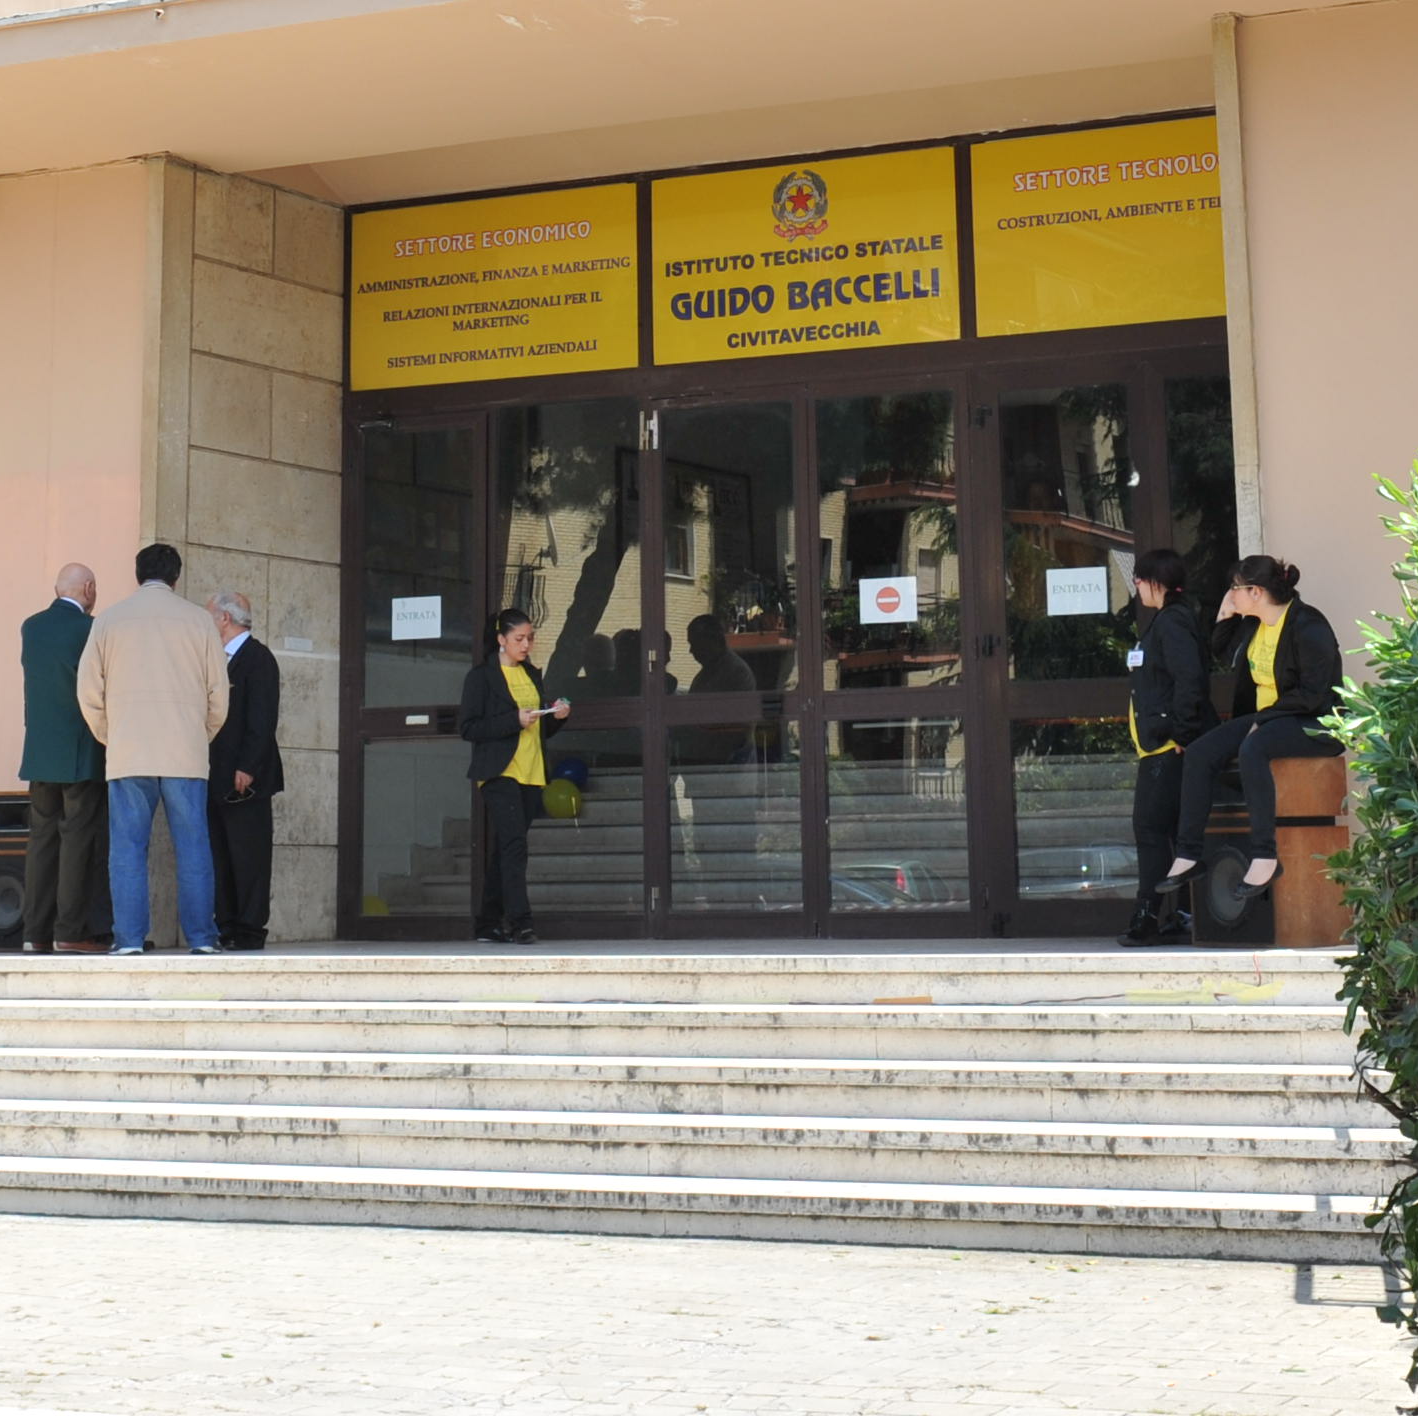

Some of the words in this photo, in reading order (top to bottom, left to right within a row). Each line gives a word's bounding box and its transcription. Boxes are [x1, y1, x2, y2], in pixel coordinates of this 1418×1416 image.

[1013, 164, 1110, 192] SETTORE
[1117, 152, 1220, 182] TECNOLO
[997, 208, 1102, 231] COSTRUZIONI,
[1106, 199, 1184, 220] AMBIENTE
[1186, 198, 1196, 211] E
[394, 233, 475, 258] SETTORE
[481, 220, 592, 248] ECONOMICO
[665, 254, 755, 277] ISTITUTO
[761, 244, 849, 268] TECNICO
[855, 234, 943, 257] STATALE
[357, 271, 479, 295] AMMINISTRAZIONE,
[482, 266, 539, 282] FINANZA
[551, 256, 631, 275] MARKETING
[383, 305, 450, 323] RELAZIONI
[452, 294, 561, 316] INTERNAZIONALI
[564, 291, 589, 305] PER
[590, 290, 603, 303] IL
[670, 284, 775, 321] GUIDO
[787, 267, 940, 312] BACCELLI
[452, 314, 530, 332] MARKETING
[727, 320, 881, 349] CIVITAVECCHIA
[387, 353, 436, 369] SISTEMI
[438, 345, 525, 364] INFORMATIVI
[527, 339, 598, 357] AZIENDALI
[1052, 583, 1102, 595] ENTRATA
[396, 610, 438, 621] ENTRATA
